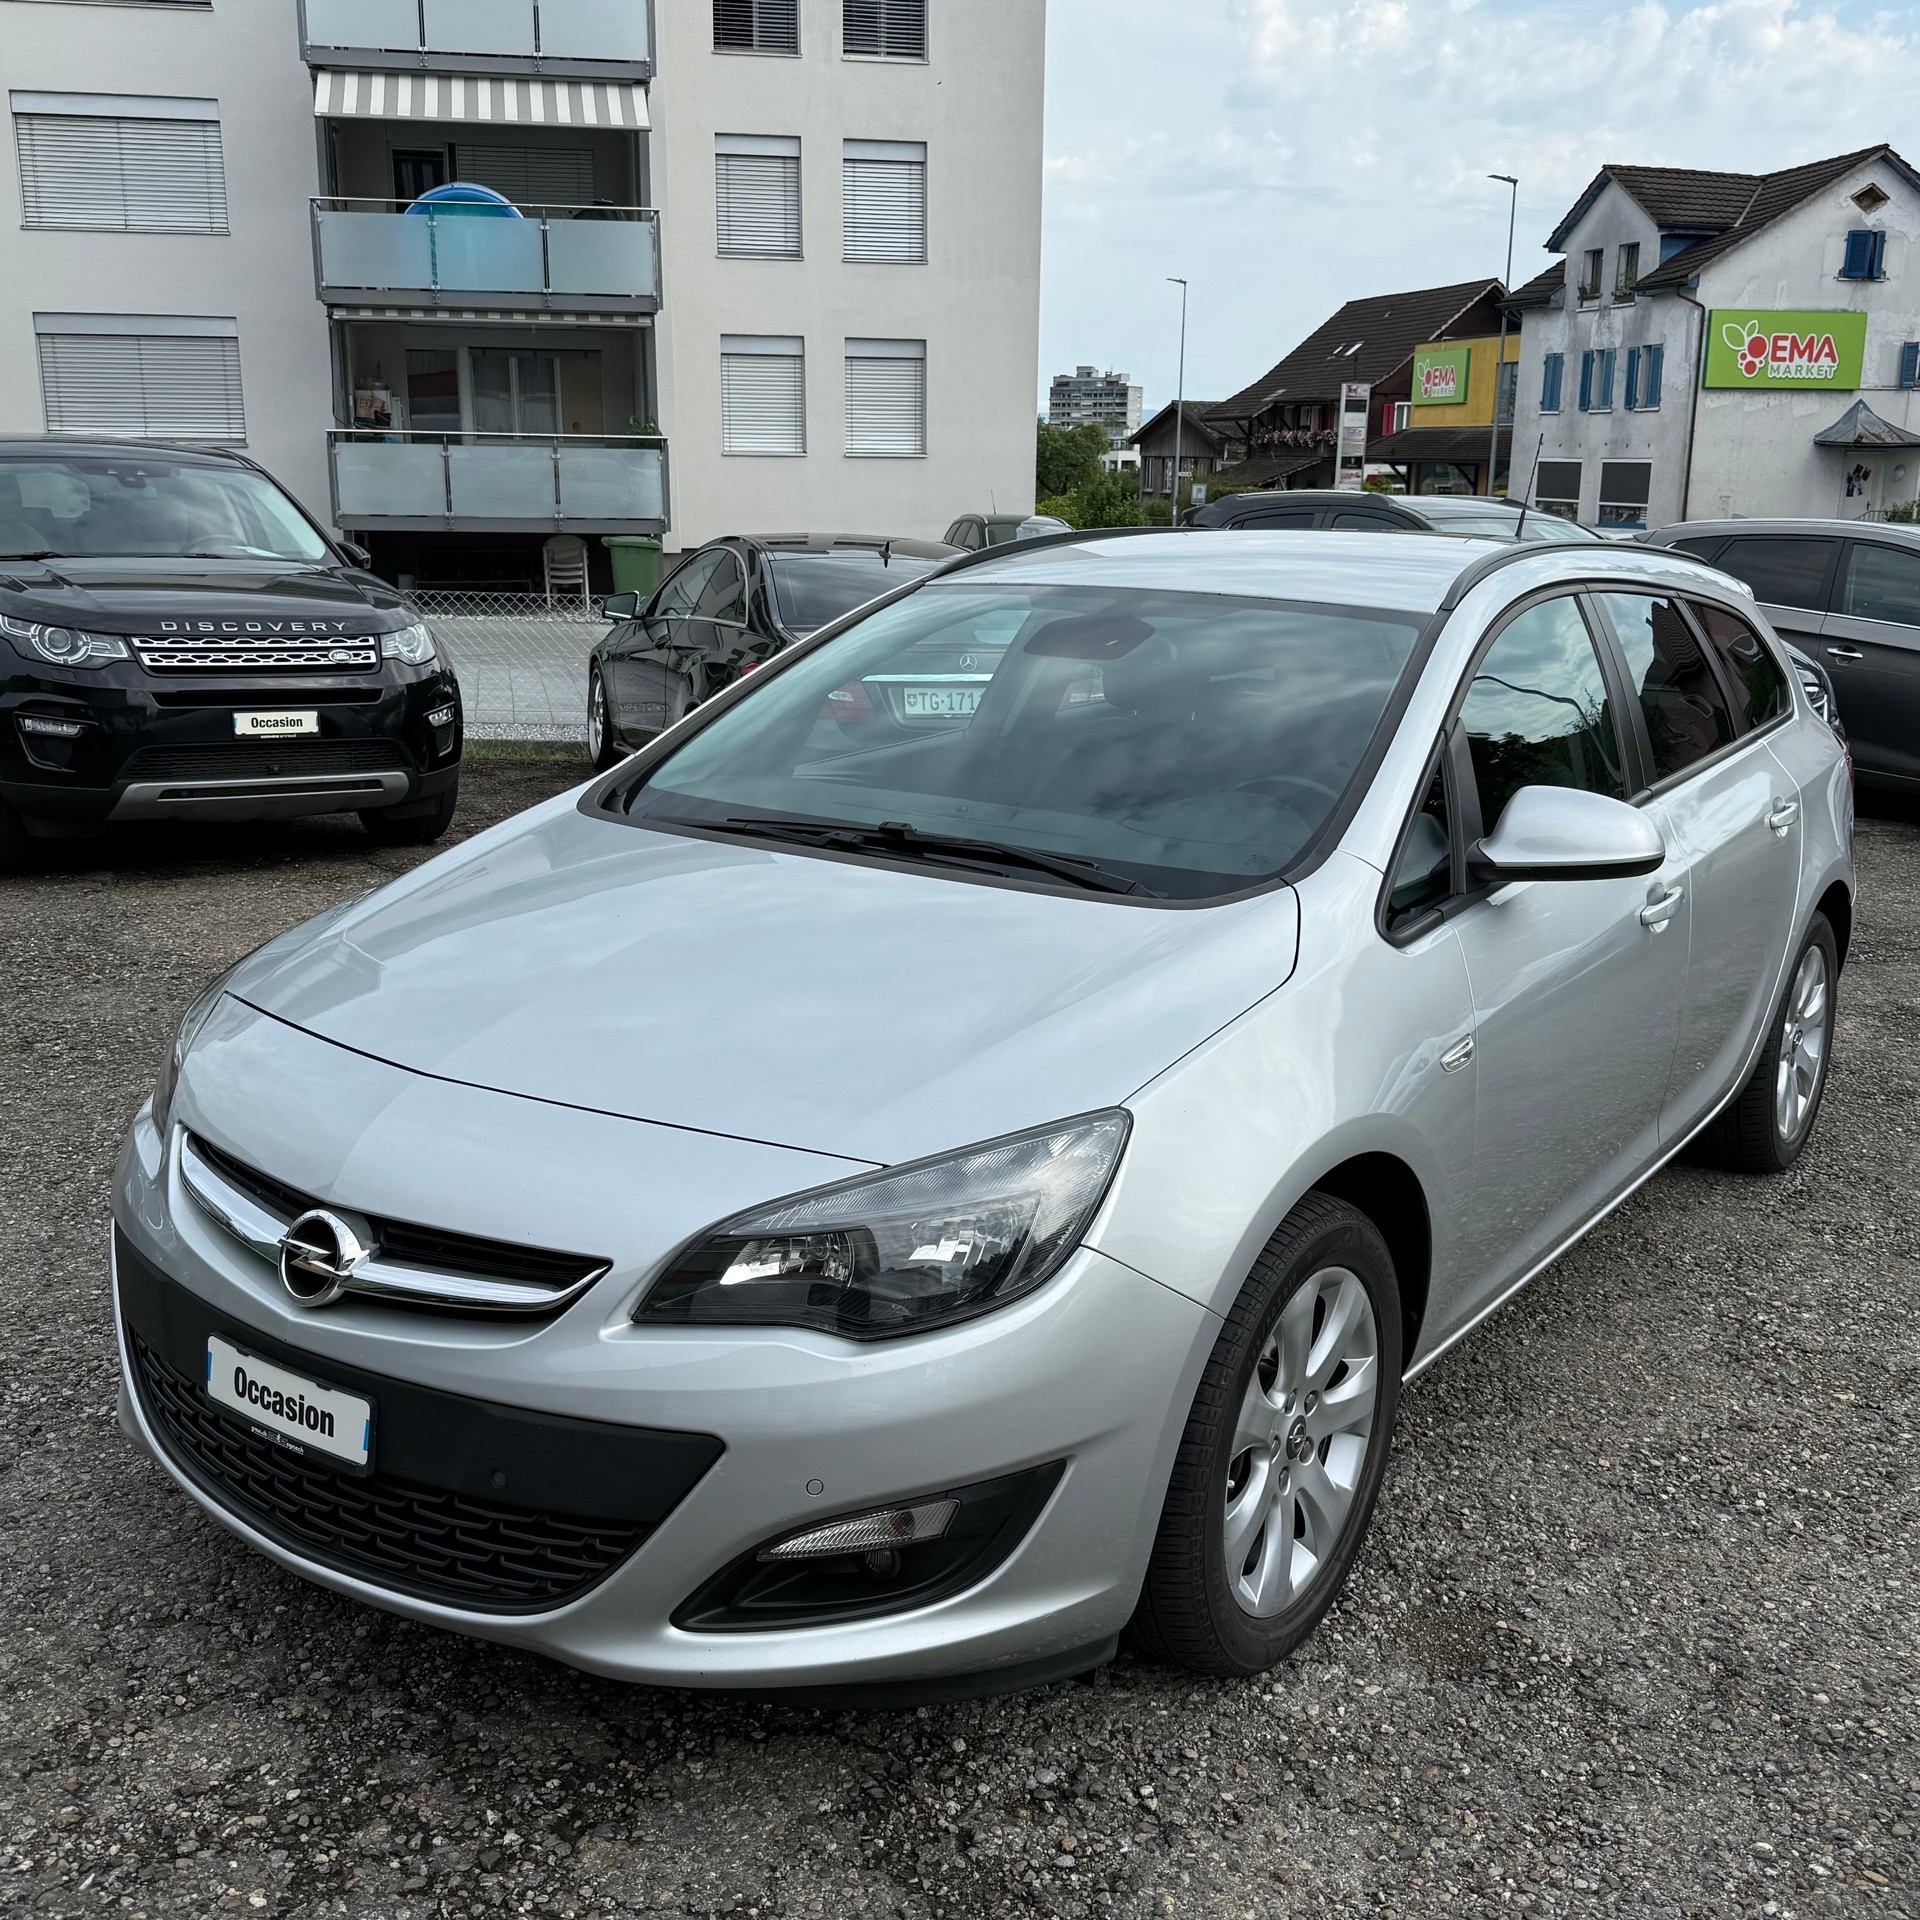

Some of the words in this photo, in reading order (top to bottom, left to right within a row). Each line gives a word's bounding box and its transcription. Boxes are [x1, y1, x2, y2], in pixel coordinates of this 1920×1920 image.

[1770, 334, 1837, 364] EMA
[1432, 366, 1456, 387] EMA
[1769, 364, 1836, 377] MARKET
[160, 621, 346, 632] DISCOVERY
[251, 716, 303, 729] Occasion
[233, 1366, 335, 1438] Occasion
